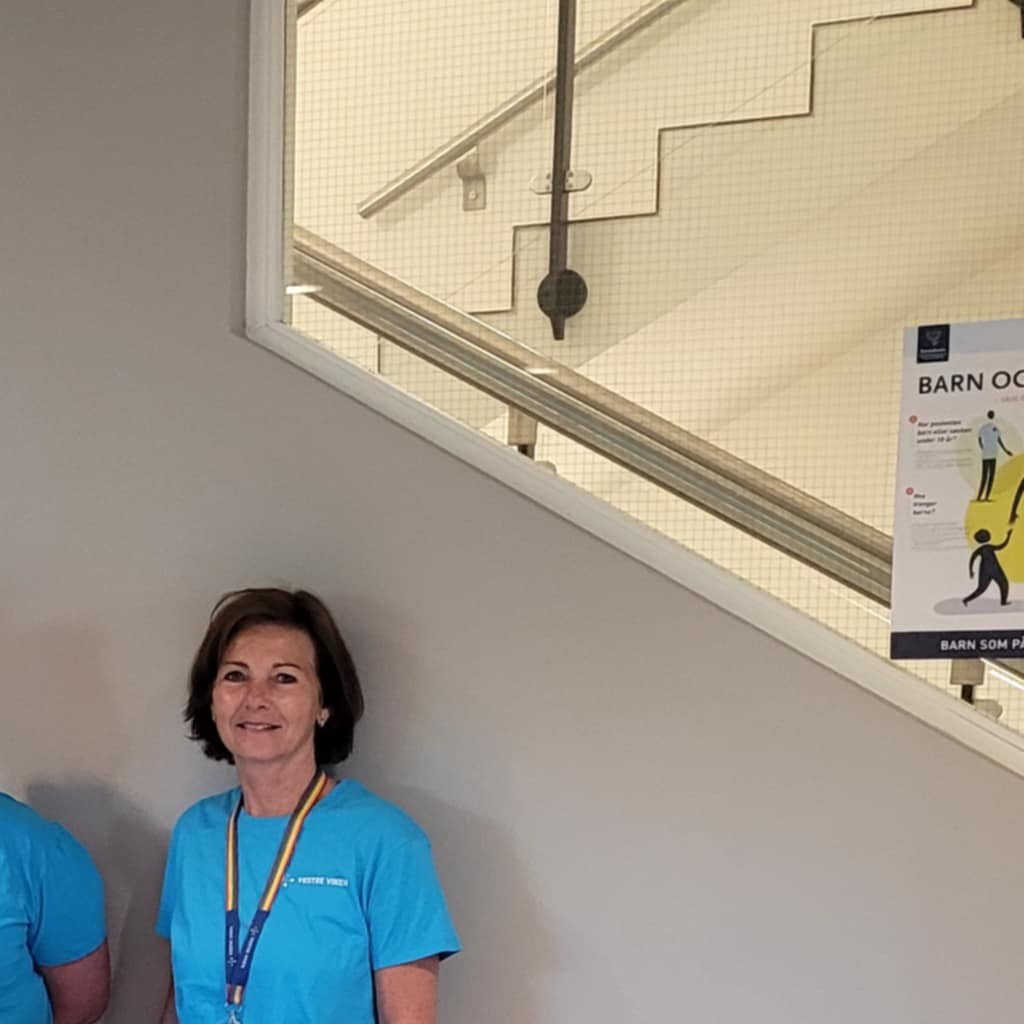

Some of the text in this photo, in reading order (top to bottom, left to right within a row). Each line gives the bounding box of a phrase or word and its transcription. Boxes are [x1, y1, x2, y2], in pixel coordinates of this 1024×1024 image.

[918, 372, 983, 394] BARN
[940, 640, 976, 651] BARN
[980, 639, 1008, 650] SOM
